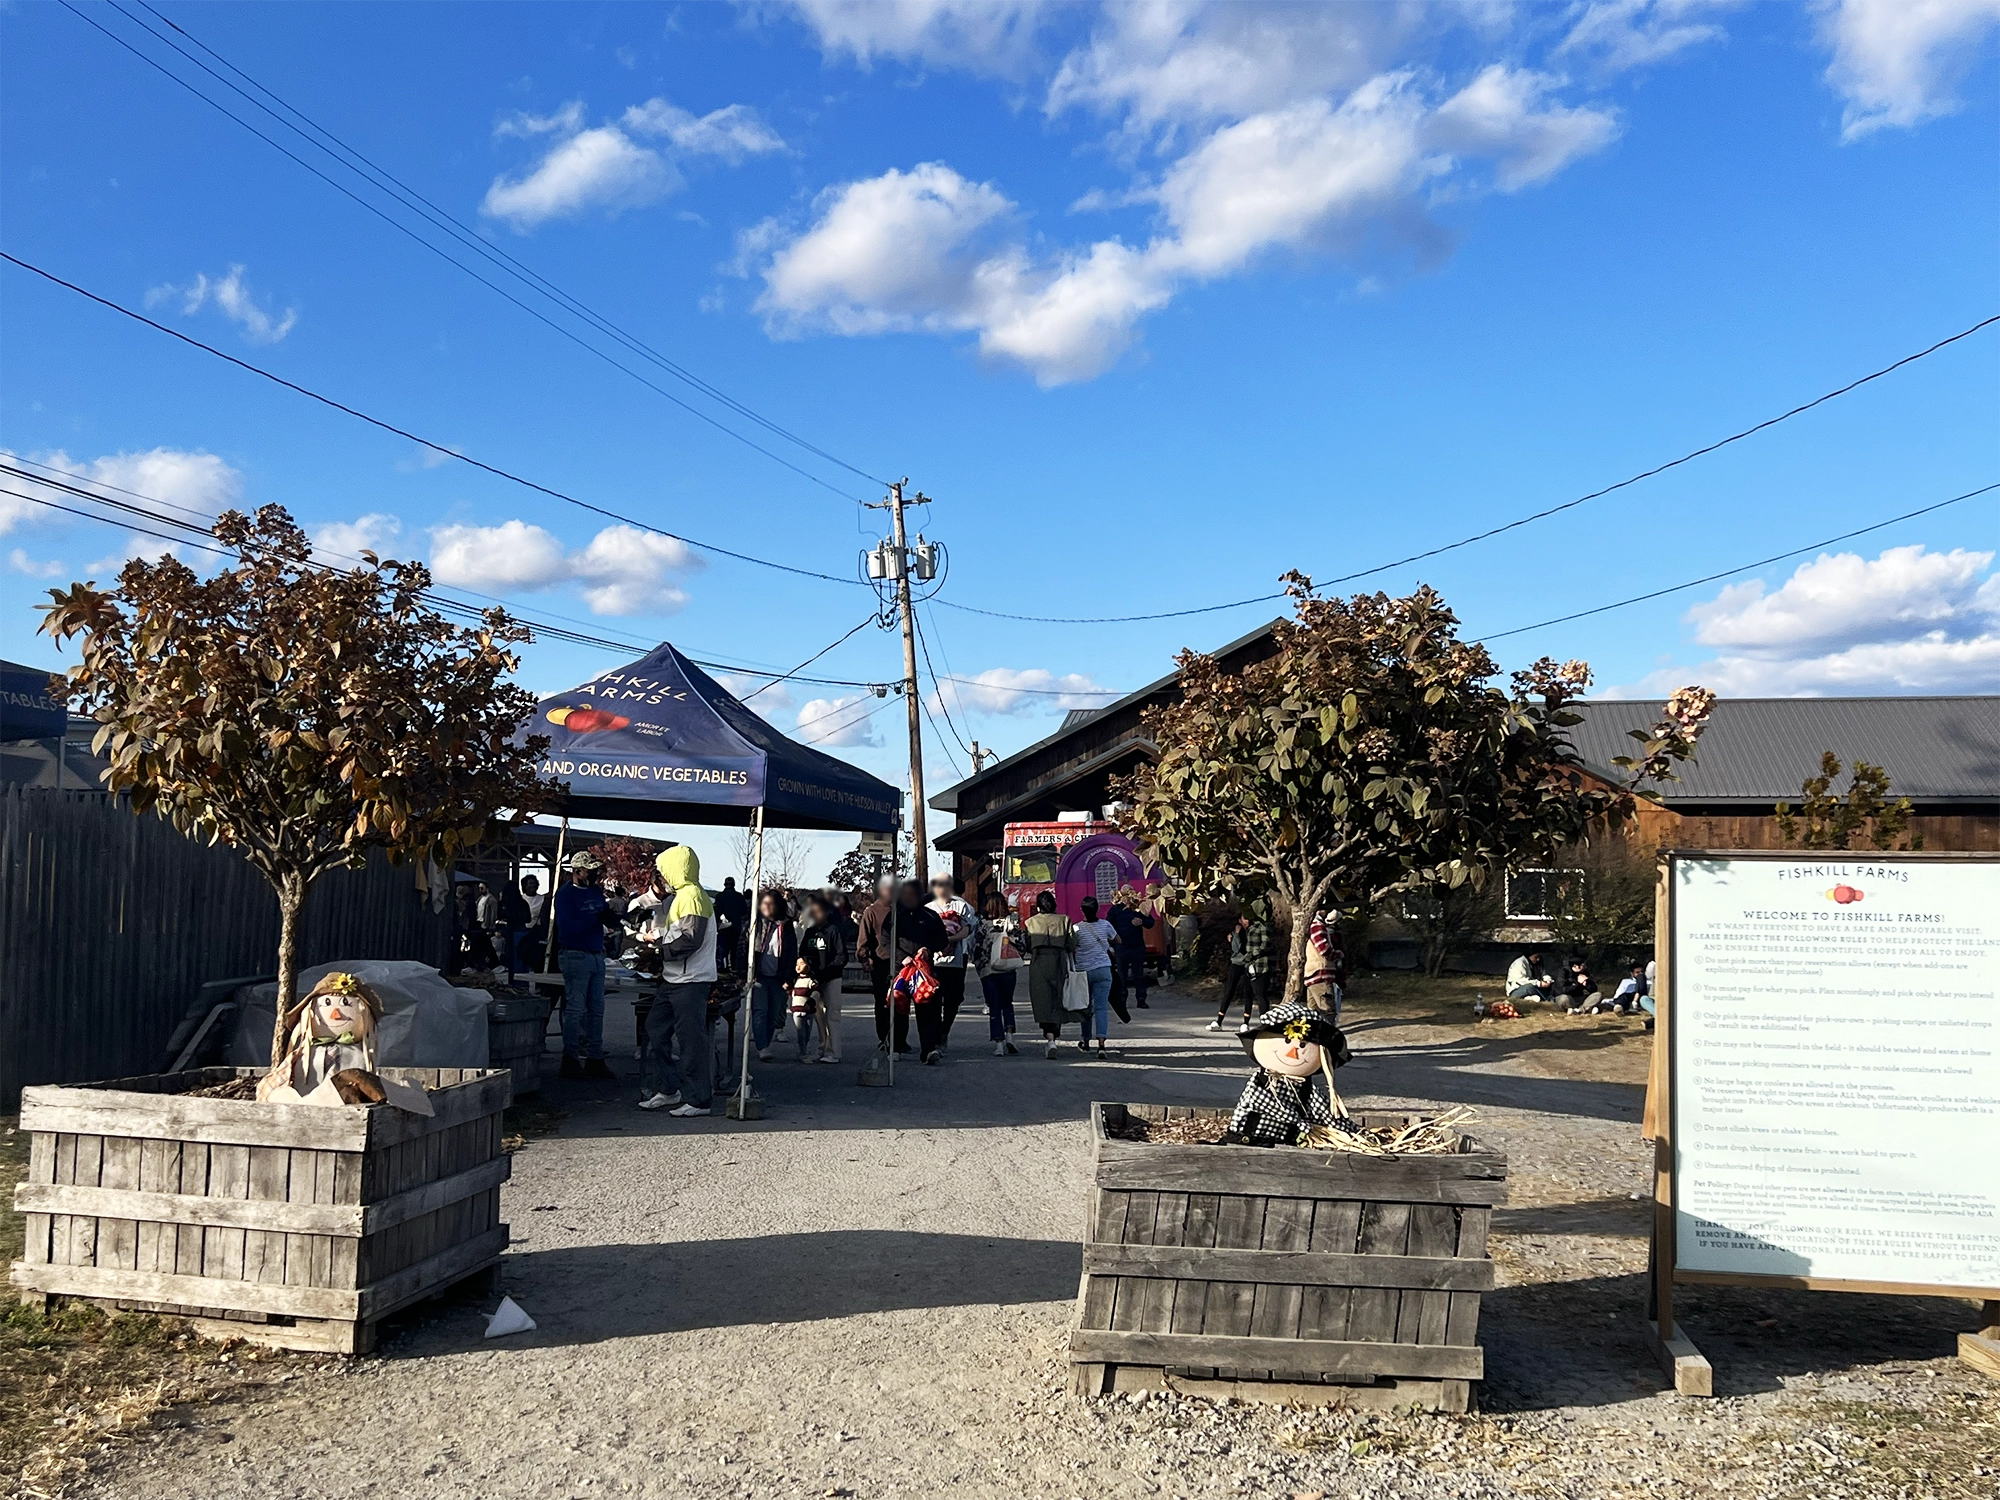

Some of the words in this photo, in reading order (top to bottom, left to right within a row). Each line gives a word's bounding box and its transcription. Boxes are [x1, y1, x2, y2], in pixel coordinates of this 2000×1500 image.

[541, 760, 574, 776] AND
[578, 762, 649, 780] ORGANIC
[652, 766, 748, 786] VEGETABLES
[778, 777, 805, 796] GROWN
[804, 782, 821, 799] WITH
[821, 786, 837, 802] LOVE
[844, 791, 854, 806] THE
[854, 794, 875, 811] HUDSON
[875, 798, 891, 814] VALLEY
[1014, 834, 1062, 843] FARMERS
[1778, 865, 1850, 881] FISHKILL
[1856, 866, 1909, 883] FARMS
[1743, 911, 1807, 920] WELCOME
[1812, 912, 1829, 921] TO
[1834, 912, 1893, 922] FISHKILL
[1898, 914, 1944, 923] FARMS!
[1695, 1230, 1732, 1239] REMOVE
[1786, 1235, 1836, 1244] VIOLATION
[1914, 1241, 1959, 1250] WITHOUT
[1768, 1224, 1821, 1234] FOLLOWING
[1894, 1231, 1933, 1240] RESERVE
[1956, 1234, 1985, 1242] RIGHT
[1835, 1247, 1867, 1256] PLEASE
[1892, 1250, 1920, 1259] WE'RE
[1923, 1252, 1952, 1260] HAPPY
